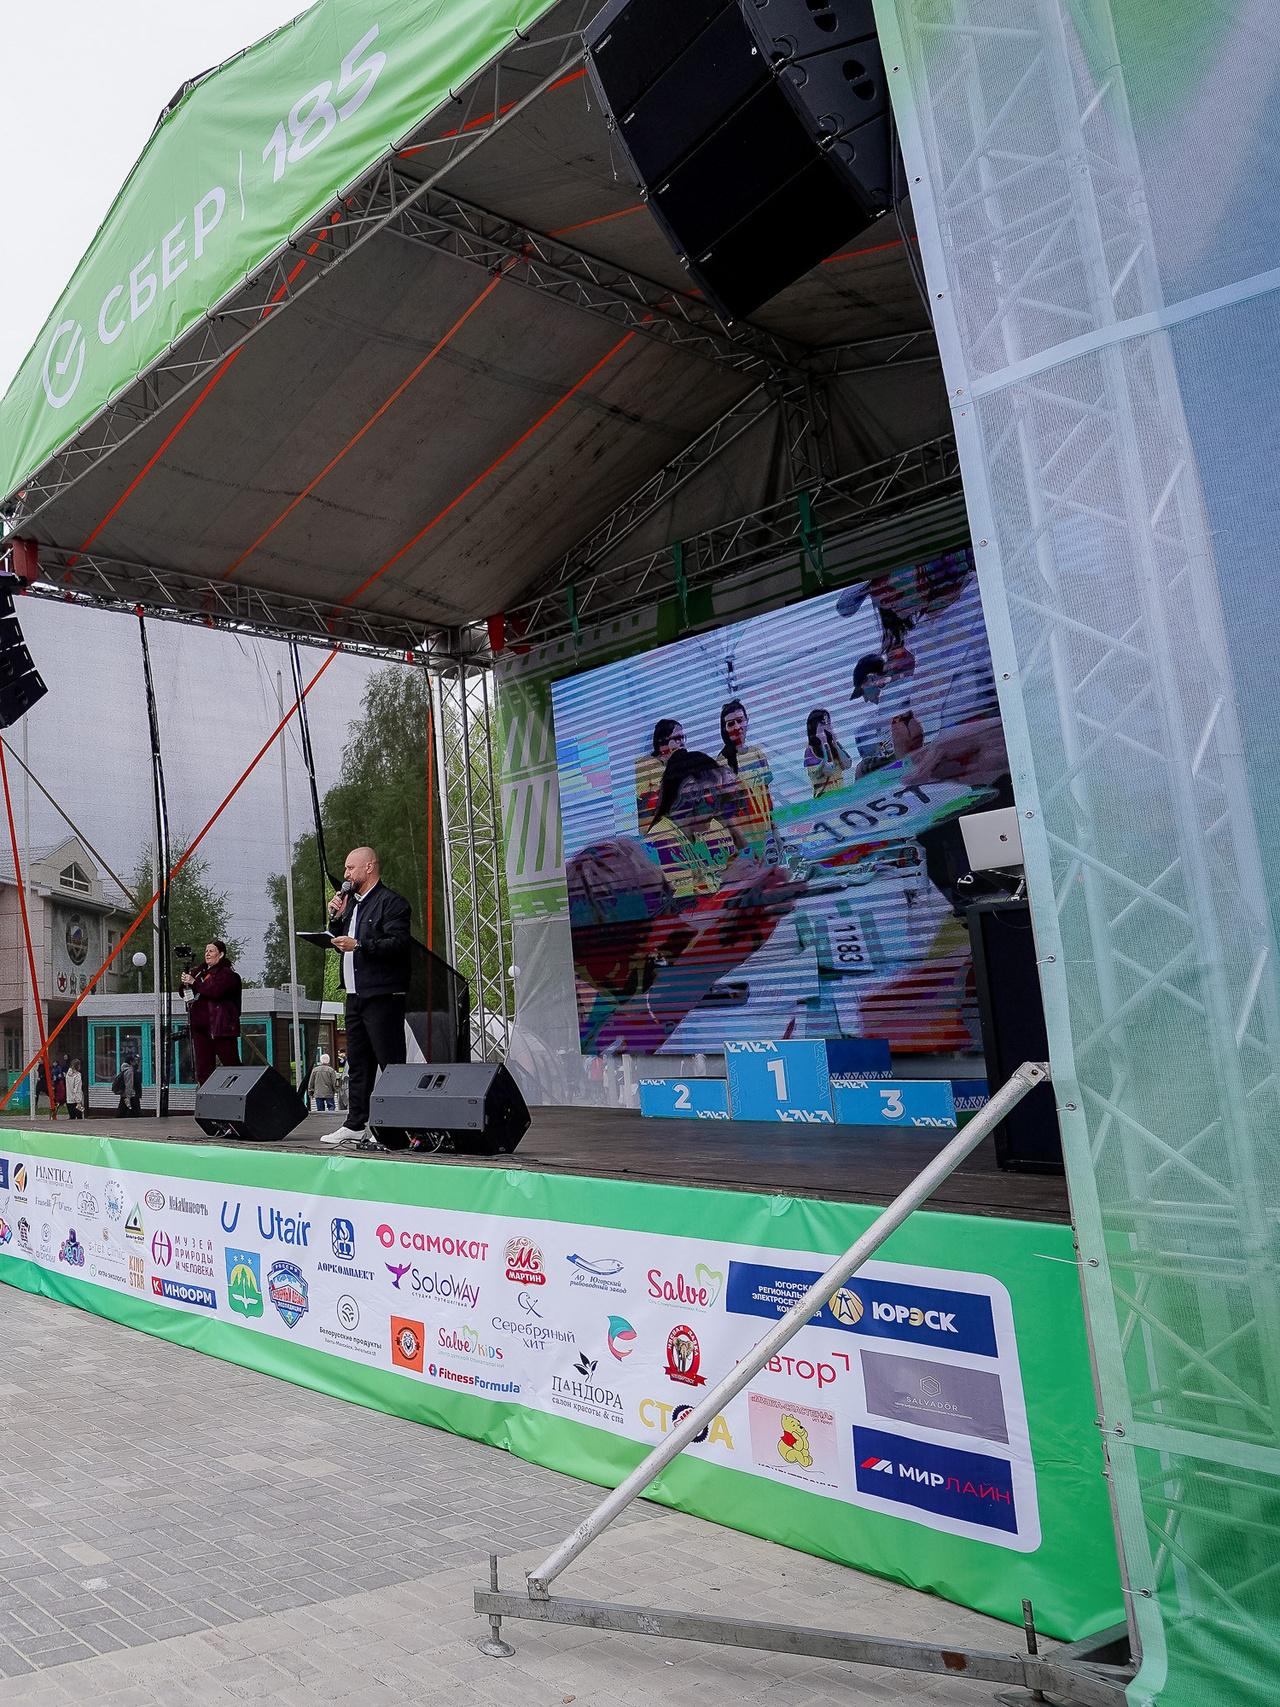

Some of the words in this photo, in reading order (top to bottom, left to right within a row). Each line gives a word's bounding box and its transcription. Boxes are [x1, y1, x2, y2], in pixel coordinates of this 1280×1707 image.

[98, 187, 226, 344] СБЕР
[262, 23, 387, 183] 185
[833, 924, 864, 963] 1183
[767, 1060, 789, 1101] 1
[673, 1084, 692, 1109] 2
[880, 1090, 904, 1118] 3
[257, 1205, 311, 1246] Utair
[174, 1235, 213, 1251] МУЗЕЙ
[175, 1248, 214, 1264] ПРИРОДЫ
[400, 1231, 489, 1261] самокат
[129, 1255, 144, 1273] KINO
[175, 1261, 181, 1270] И
[181, 1263, 215, 1277] ЧЕЛОВЕКА
[317, 1261, 375, 1281] ДОРКОМПЛЕКТ
[129, 1272, 145, 1291] STAR
[508, 1271, 542, 1284] МАРТИН
[609, 1286, 627, 1294] завод
[647, 1269, 709, 1306] Salve
[164, 1282, 212, 1306] ИНФОРМ
[872, 1301, 959, 1333] ЮРЭСК
[319, 1326, 352, 1341] Белорусские
[352, 1337, 382, 1349] продукты
[438, 1327, 471, 1353] Salve
[491, 1317, 575, 1344] Серебряный
[439, 1367, 521, 1394] FitnessFormula
[552, 1375, 624, 1410] ПАНДОРА
[552, 1396, 572, 1408] салон
[573, 1403, 601, 1417] красоты
[603, 1410, 610, 1420] &
[611, 1415, 624, 1424] спа
